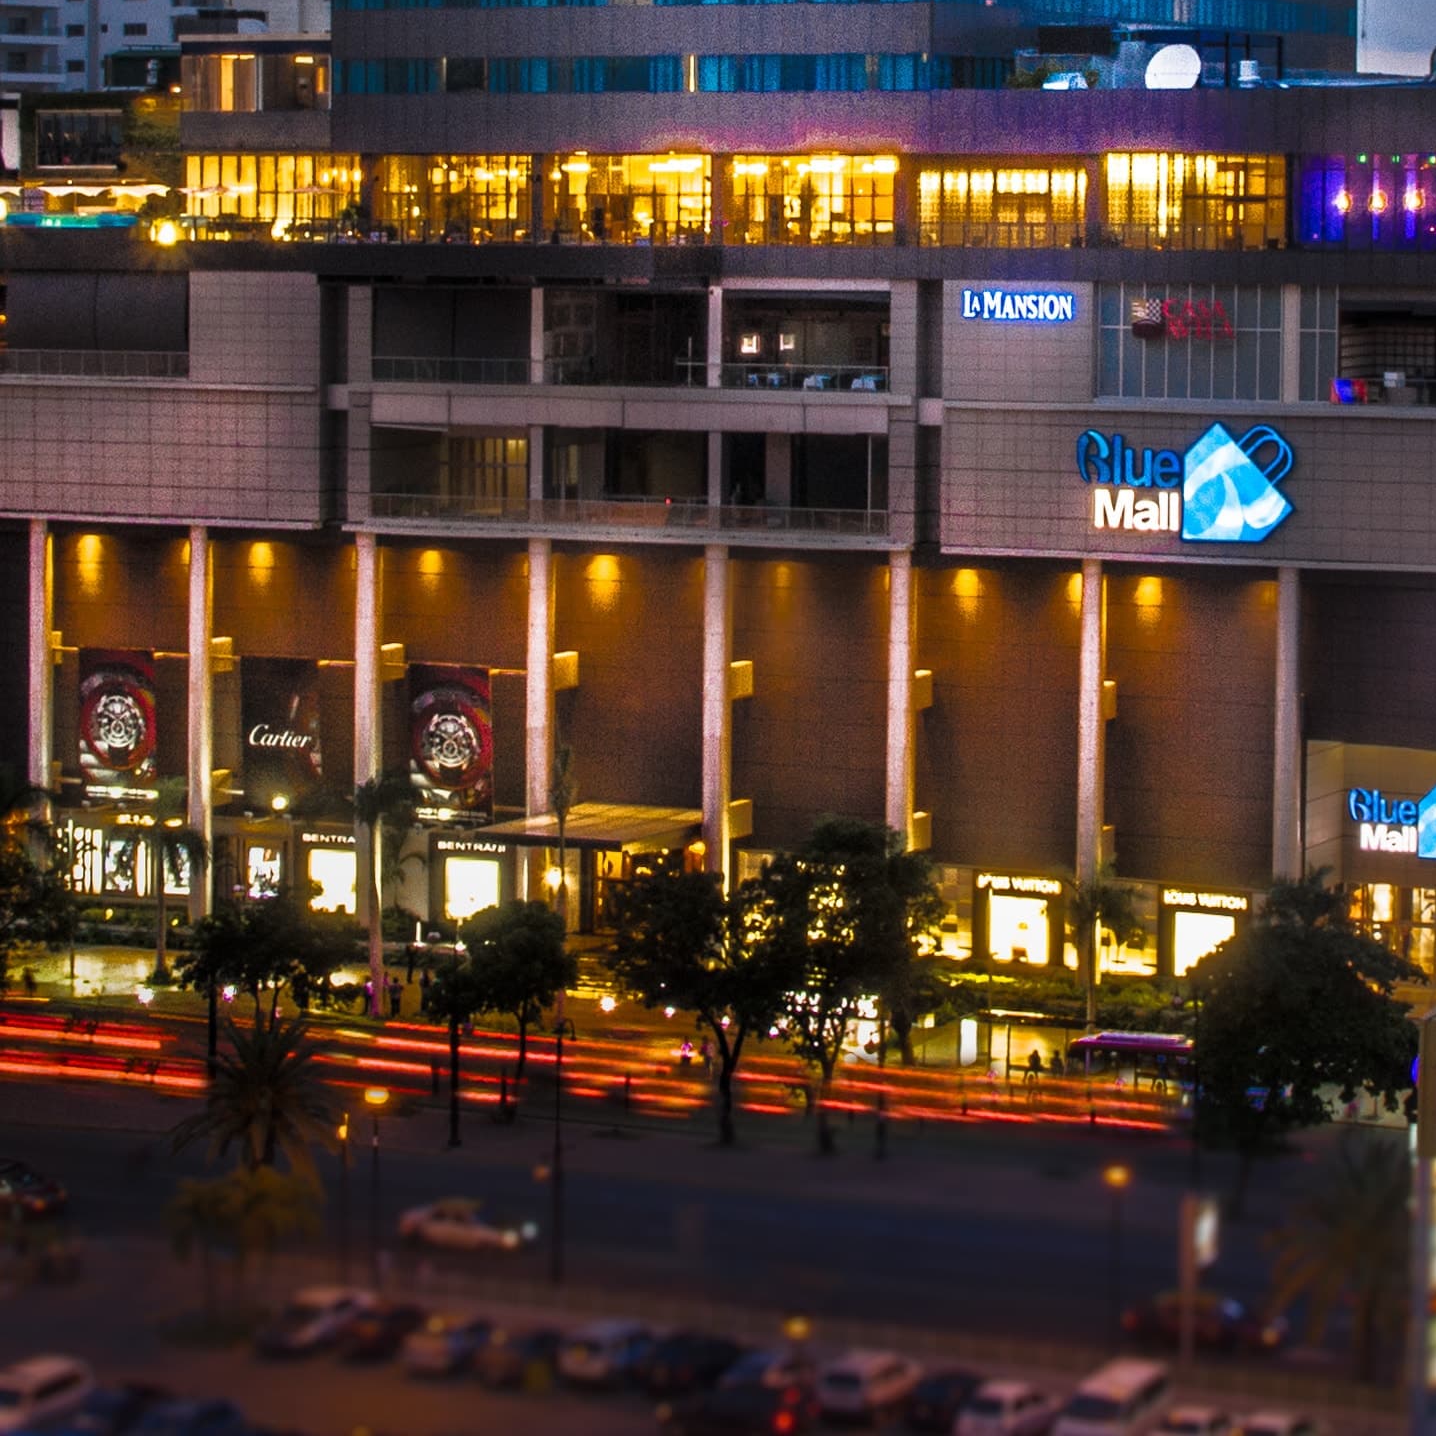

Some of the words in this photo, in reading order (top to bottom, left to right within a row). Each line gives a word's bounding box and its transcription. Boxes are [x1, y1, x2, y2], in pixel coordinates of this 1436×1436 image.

[983, 291, 1072, 320] MANSION
[1161, 298, 1226, 318] CASA
[1077, 429, 1181, 488] Blue
[1094, 488, 1179, 531] Mall
[249, 723, 313, 748] Cartier
[1348, 787, 1417, 824] Blue
[1360, 823, 1418, 852] Mall
[1163, 888, 1197, 906] LOUIS
[1197, 892, 1247, 910] VUITTON
